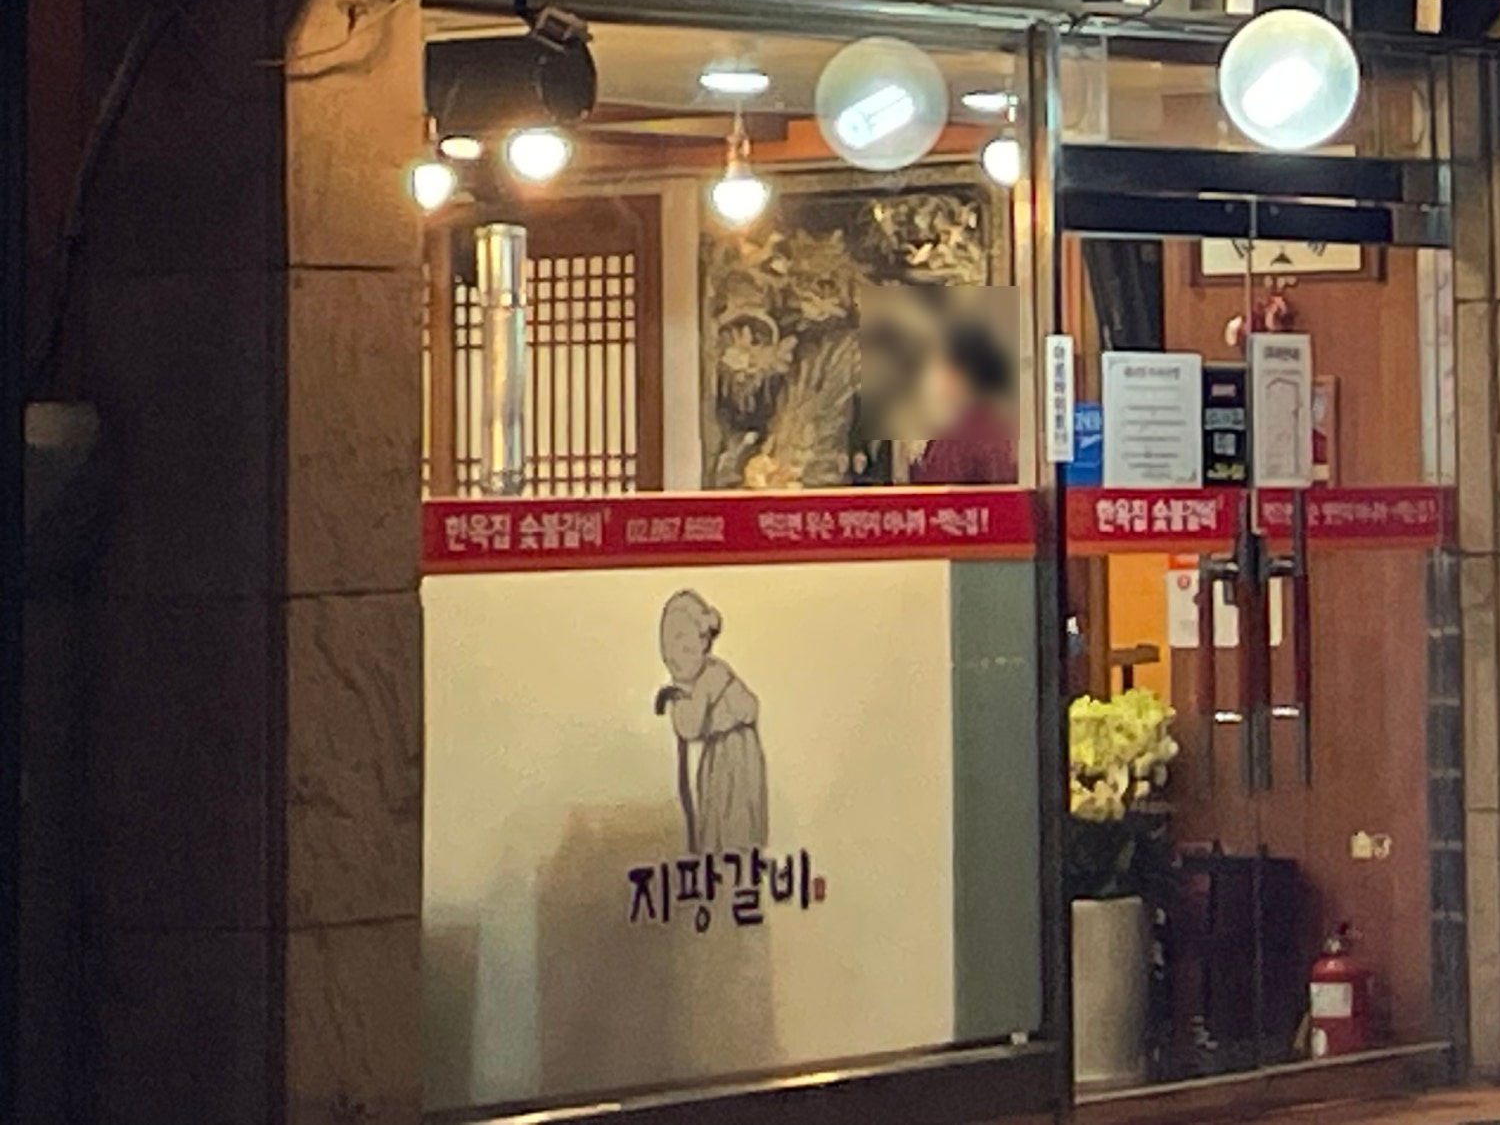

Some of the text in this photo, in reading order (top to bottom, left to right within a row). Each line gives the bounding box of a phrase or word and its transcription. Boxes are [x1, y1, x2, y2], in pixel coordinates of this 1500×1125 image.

[444, 512, 512, 553] 한옥집
[518, 511, 603, 551] 숯불갈비
[627, 847, 811, 934] 지팡갈비
